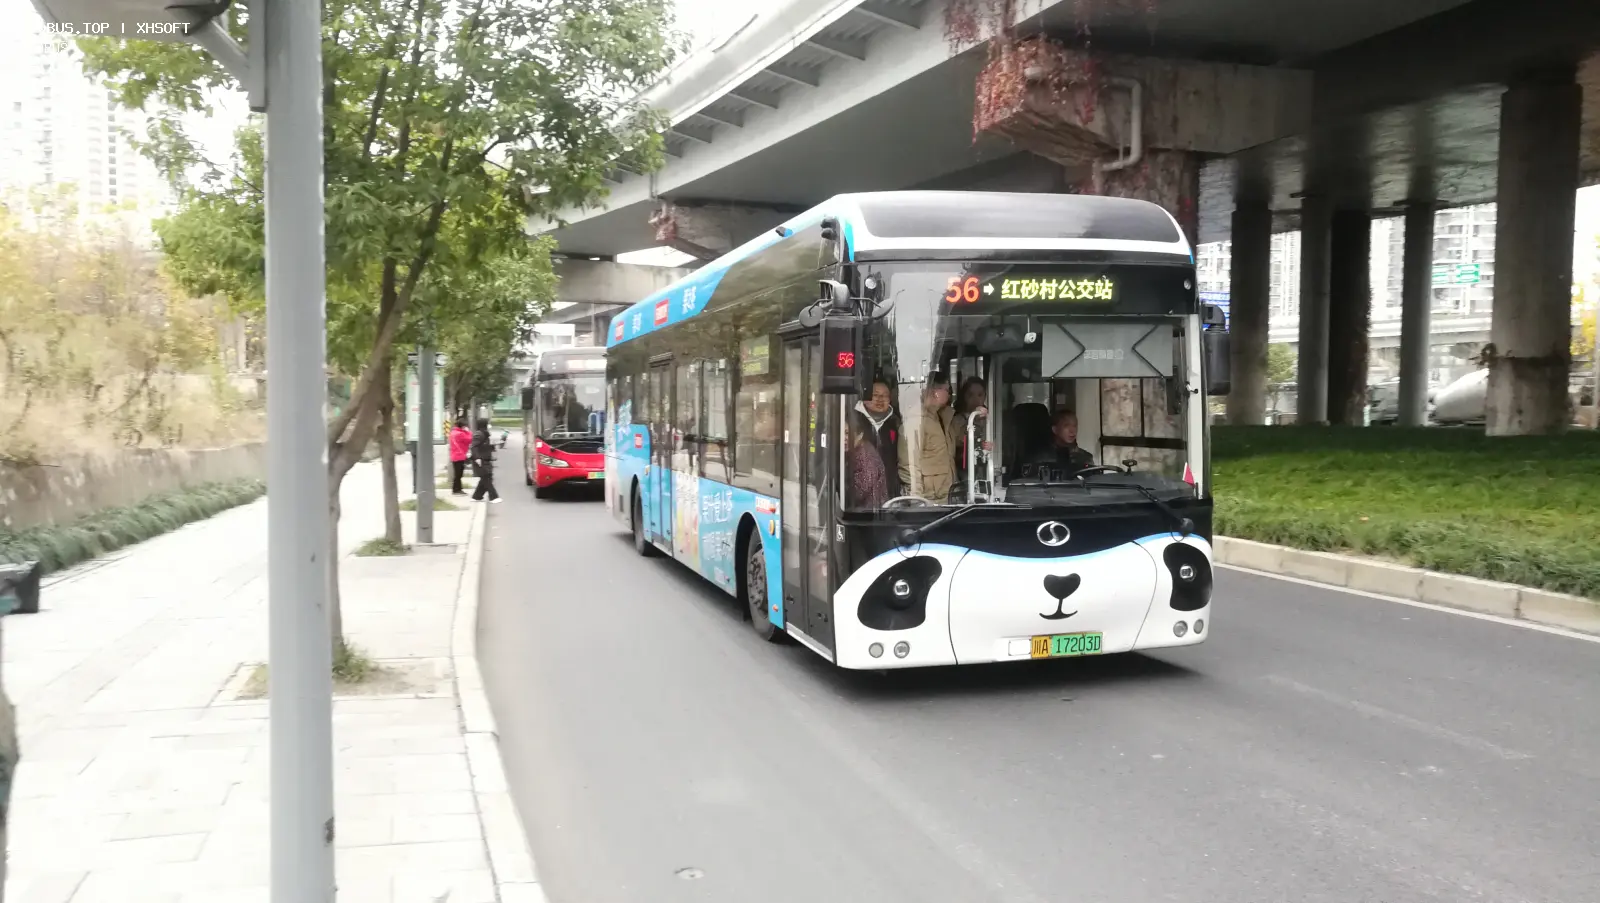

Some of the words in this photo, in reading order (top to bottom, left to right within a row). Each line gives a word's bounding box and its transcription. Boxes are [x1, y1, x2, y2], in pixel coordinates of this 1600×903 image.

[945, 276, 980, 304] 56
[1001, 278, 1114, 300] 红砂村公交站
[838, 352, 855, 369] 56
